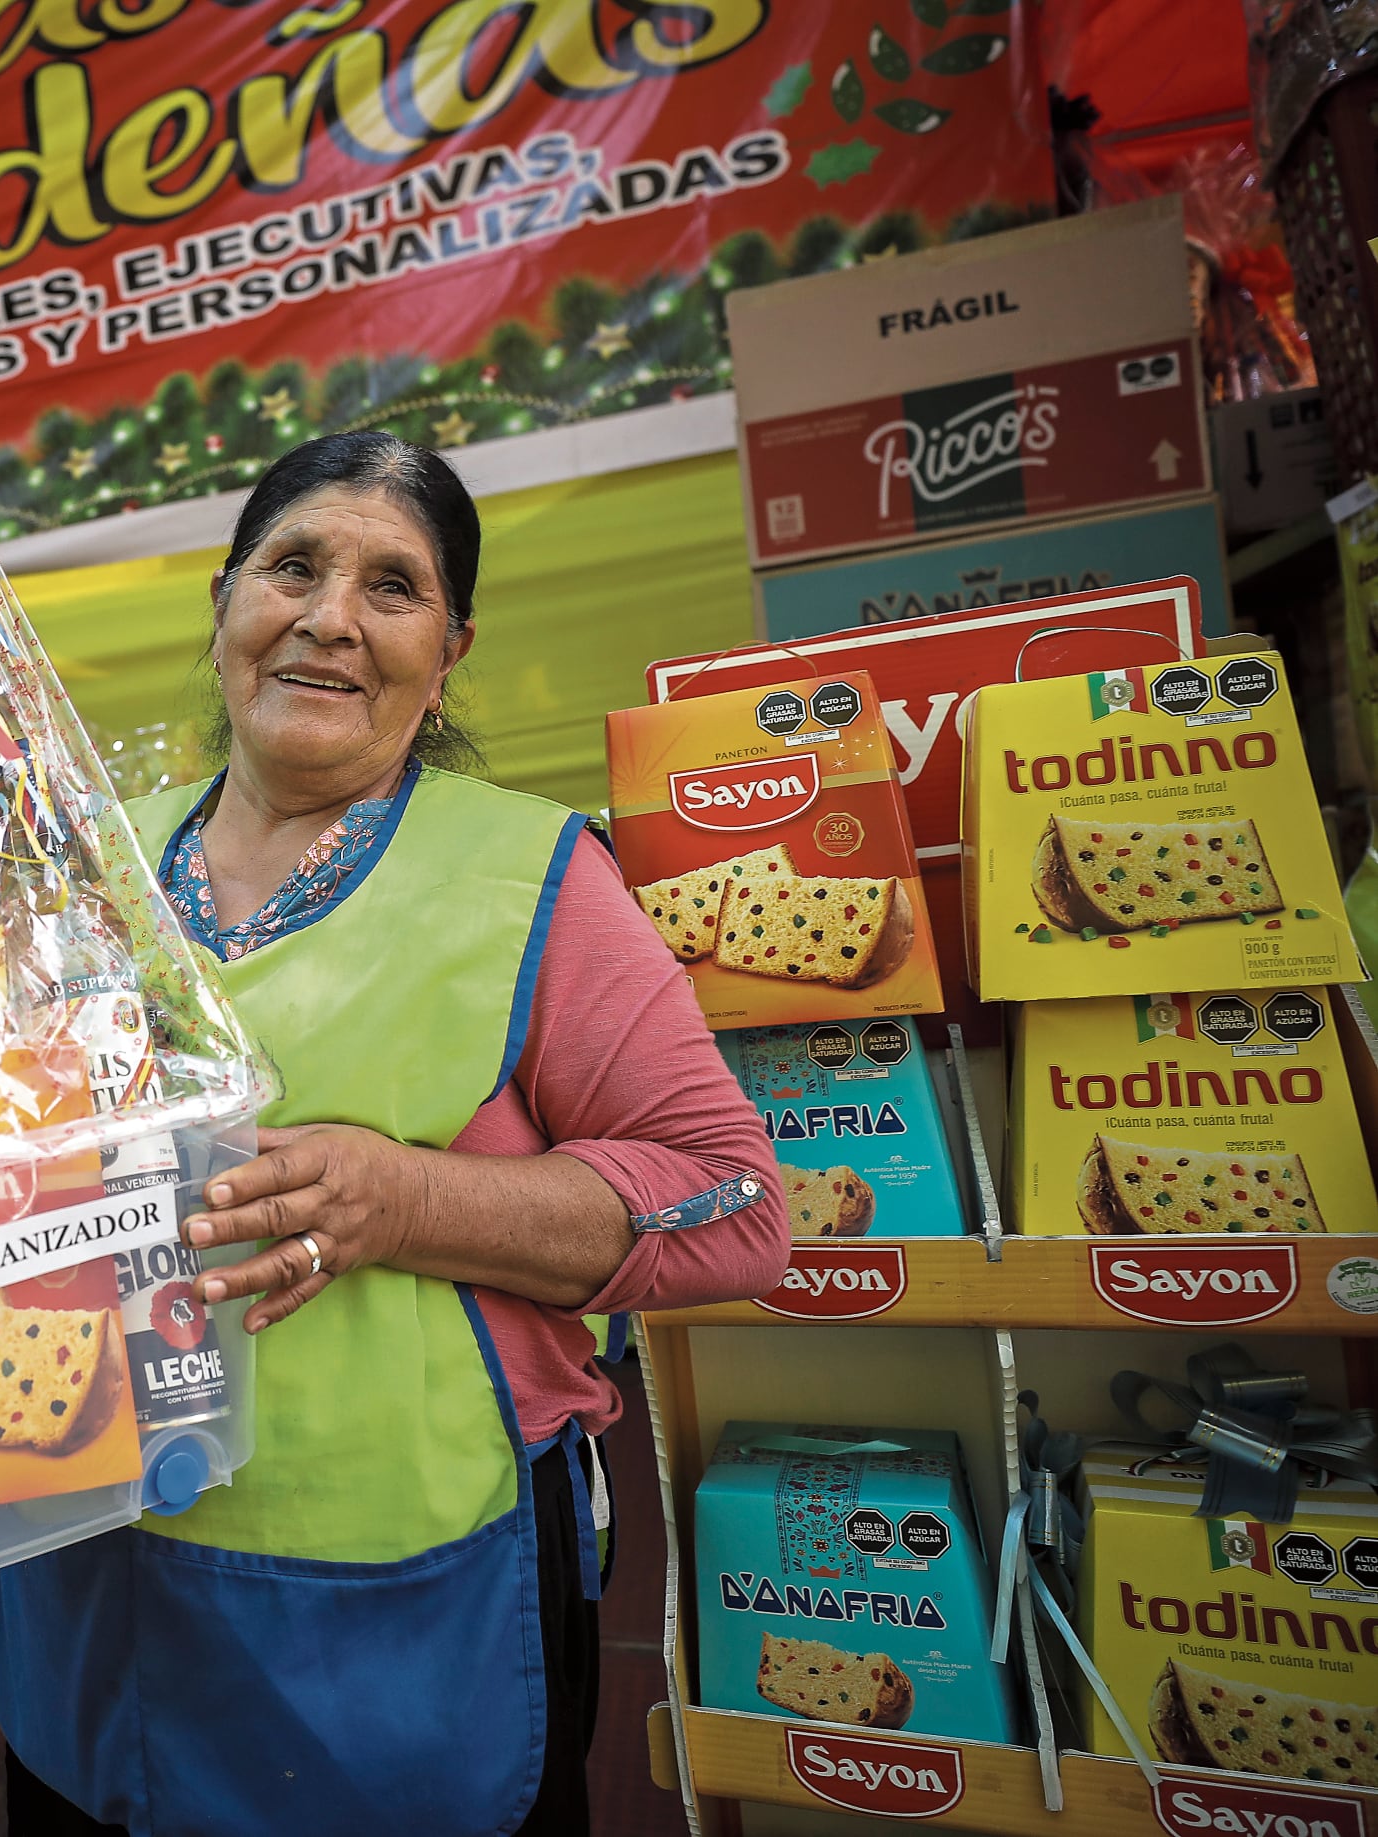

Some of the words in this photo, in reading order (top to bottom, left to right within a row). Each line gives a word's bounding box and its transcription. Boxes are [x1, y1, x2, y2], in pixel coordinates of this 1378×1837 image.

[123, 134, 599, 294] EJECUTIVAS,
[41, 322, 81, 360] Y
[106, 133, 786, 347] PERSONALIZADAS
[878, 290, 1020, 338] FRÁGIL
[1227, 675, 1251, 684] ALTO
[1252, 673, 1266, 681] EN
[1163, 682, 1185, 691] ALTO
[1163, 686, 1200, 696] GRASAS
[1228, 682, 1267, 693] AZÚCAR
[819, 698, 839, 707] ALTO
[1157, 692, 1209, 703] SATURADAS
[765, 704, 785, 713] ALTO
[786, 702, 796, 710] EN
[820, 703, 853, 714] AZÚCAR
[766, 709, 797, 718] GRASAS
[761, 714, 804, 725] SATURADAS
[715, 745, 768, 761] PANETON
[1003, 730, 1278, 794] todinno
[683, 774, 808, 810] Sayon
[1060, 794, 1106, 809] ¡Cuánta
[1110, 791, 1143, 806] pasa,
[1147, 785, 1189, 799] cuánta
[1193, 780, 1227, 794] fruta!
[829, 821, 849, 834] 30
[824, 833, 854, 842] AÑOS
[1245, 943, 1269, 954] 900
[1272, 943, 1280, 955] g
[1248, 957, 1285, 968] PANETÓN
[1286, 957, 1303, 967] CON
[1305, 955, 1336, 965] FRUTAS
[1249, 968, 1300, 980] CONFITADAS
[1307, 967, 1333, 976] PASAS
[1274, 1009, 1298, 1017] ALTO
[1275, 1016, 1313, 1025] AZÚCAR
[1203, 1022, 1255, 1031] SATURADAS
[815, 1038, 835, 1046] ALTO
[869, 1036, 889, 1044] ALTO
[869, 1042, 901, 1051] AZÚCAR
[810, 1049, 853, 1058] SATURADAS
[1049, 1060, 1323, 1111] todinno
[1105, 1115, 1151, 1129] ¡Cuánta
[1156, 1117, 1189, 1129] pasa,
[1193, 1114, 1236, 1126] cuánta
[1240, 1113, 1274, 1125] fruta!
[125, 1173, 180, 1190] VENEZOLANA
[899, 1172, 918, 1180] 1956
[113, 1241, 202, 1301] GLORI
[776, 1267, 892, 1296] ayon
[1109, 1258, 1280, 1299] Sayon
[144, 1349, 224, 1391] LECHE
[167, 1396, 182, 1404] CON
[854, 1528, 885, 1536] GRASAS
[849, 1533, 892, 1543] SATURADAS
[909, 1535, 941, 1543] AZÚCAR
[1285, 1547, 1309, 1556] ALTO
[1287, 1554, 1324, 1564] GRASAS
[1354, 1555, 1378, 1564] ALTO
[1280, 1560, 1333, 1571] SATURADAS
[720, 1573, 947, 1630] D'ANAFRIA
[1178, 1643, 1226, 1659] ¡Cuánta
[1230, 1649, 1264, 1664] pasa,
[1269, 1653, 1314, 1669] cuánta
[1318, 1657, 1354, 1673] fruta!
[938, 1669, 958, 1677] 1956
[803, 1744, 949, 1794] Sayon
[1172, 1790, 1351, 1837] Sayon
